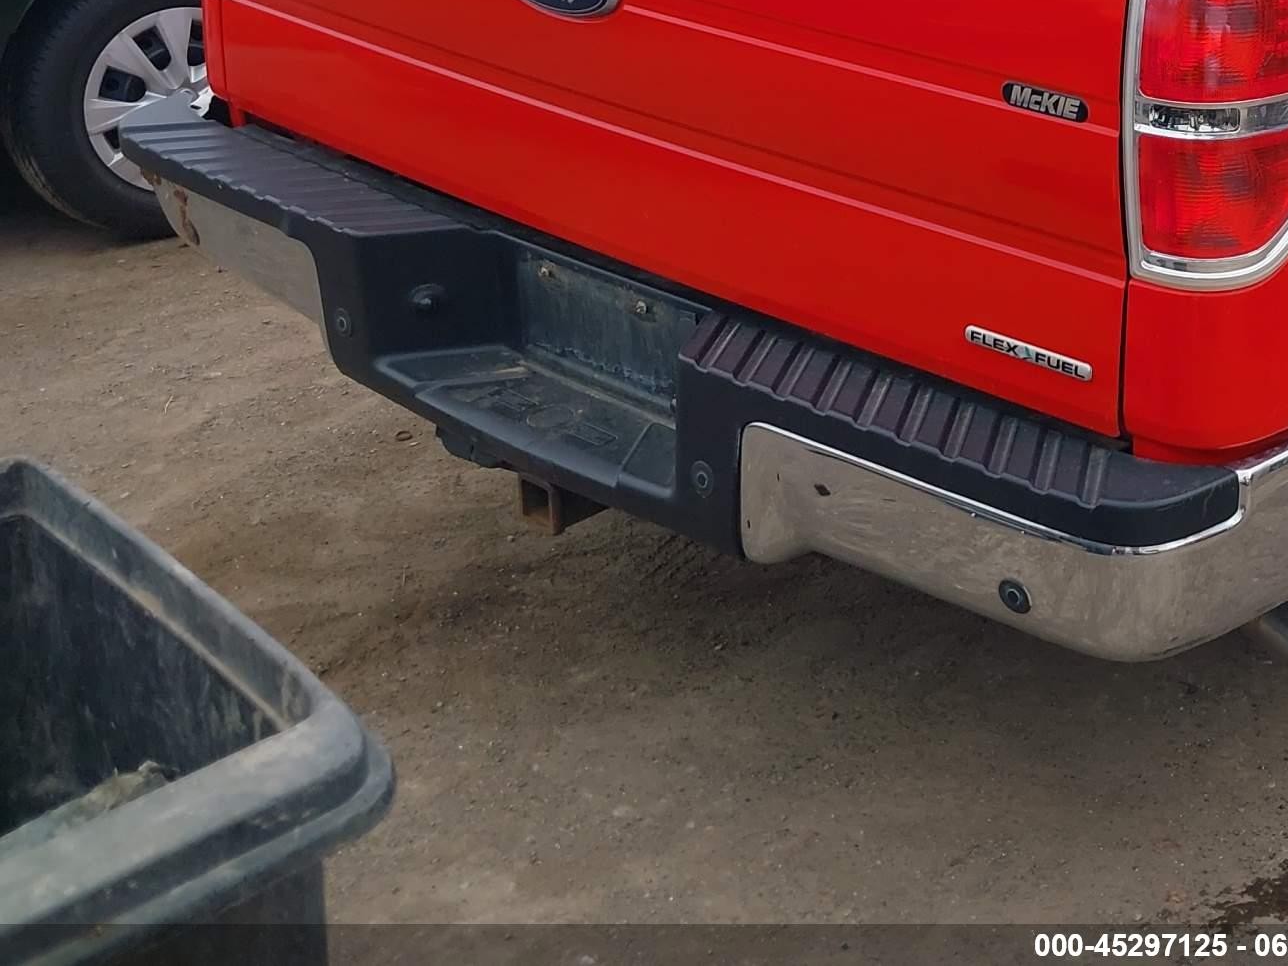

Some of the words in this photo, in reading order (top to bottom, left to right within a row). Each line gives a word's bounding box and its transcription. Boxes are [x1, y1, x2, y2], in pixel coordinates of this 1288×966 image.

[1010, 84, 1081, 120] McKIE
[970, 329, 1019, 356] FLEX
[1034, 352, 1086, 379] FUEL
